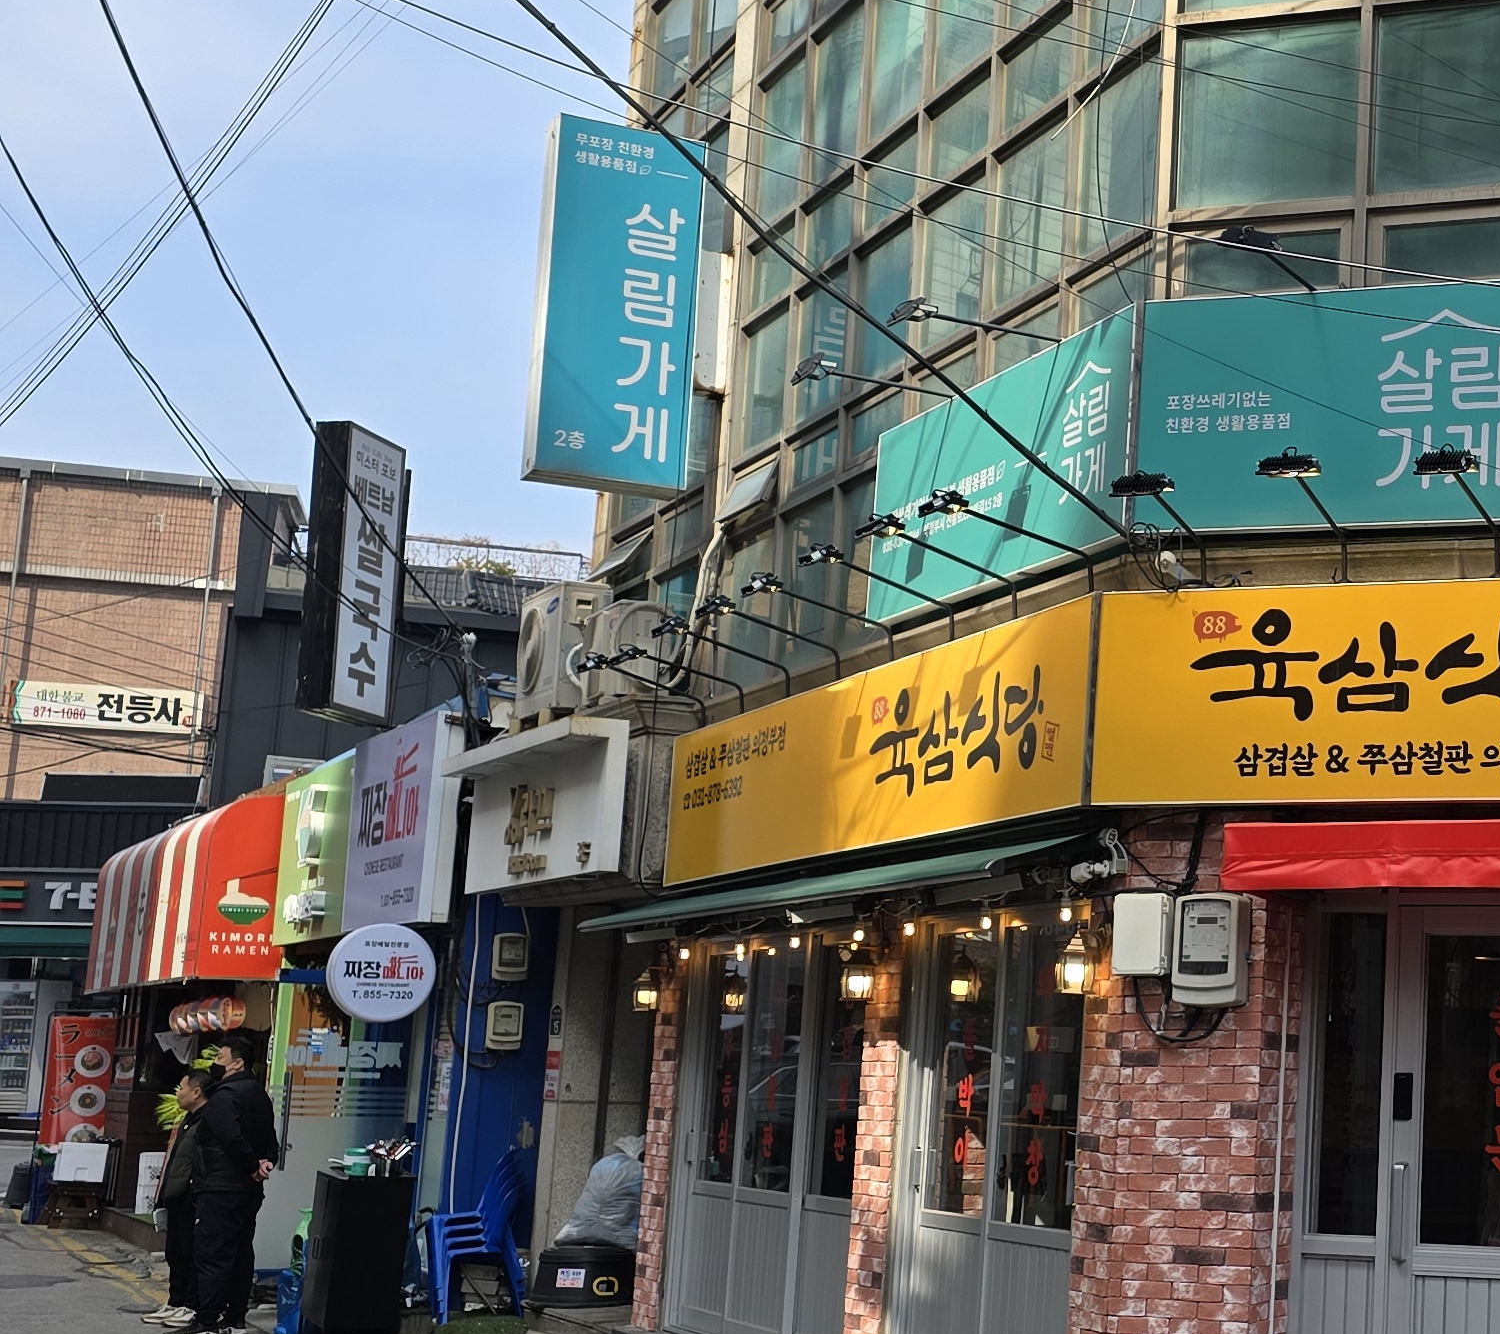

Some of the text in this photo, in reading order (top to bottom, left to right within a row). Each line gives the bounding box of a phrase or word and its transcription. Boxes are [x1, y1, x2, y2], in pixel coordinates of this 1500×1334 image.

[575, 150, 637, 173] 생활용품점
[576, 133, 654, 159] 무포장 친환경
[611, 203, 686, 464] 살림가게
[1063, 380, 1110, 448] 살림
[1166, 390, 1272, 412] 포장쓰레기없는
[554, 429, 586, 450] 2층
[1165, 412, 1291, 435] 친환경 생활용품점
[356, 450, 379, 474] 미스터
[1058, 440, 1107, 505] 가게
[354, 475, 395, 517] 베트남
[348, 516, 386, 698] 쌀국수
[1202, 615, 1227, 635] 88
[97, 693, 182, 726] 전등사
[869, 664, 1045, 797] 육삼식당
[686, 746, 708, 779] 삼겹살
[709, 746, 717, 770] &
[752, 720, 786, 758] 의정부점
[1234, 742, 1318, 777] 삼겹살
[1325, 744, 1350, 774] &
[1356, 740, 1474, 777] 쭈삼철판
[209, 931, 273, 943] KIMORI
[211, 944, 269, 956] RAMEN
[49, 1023, 82, 1116] ラーメン
